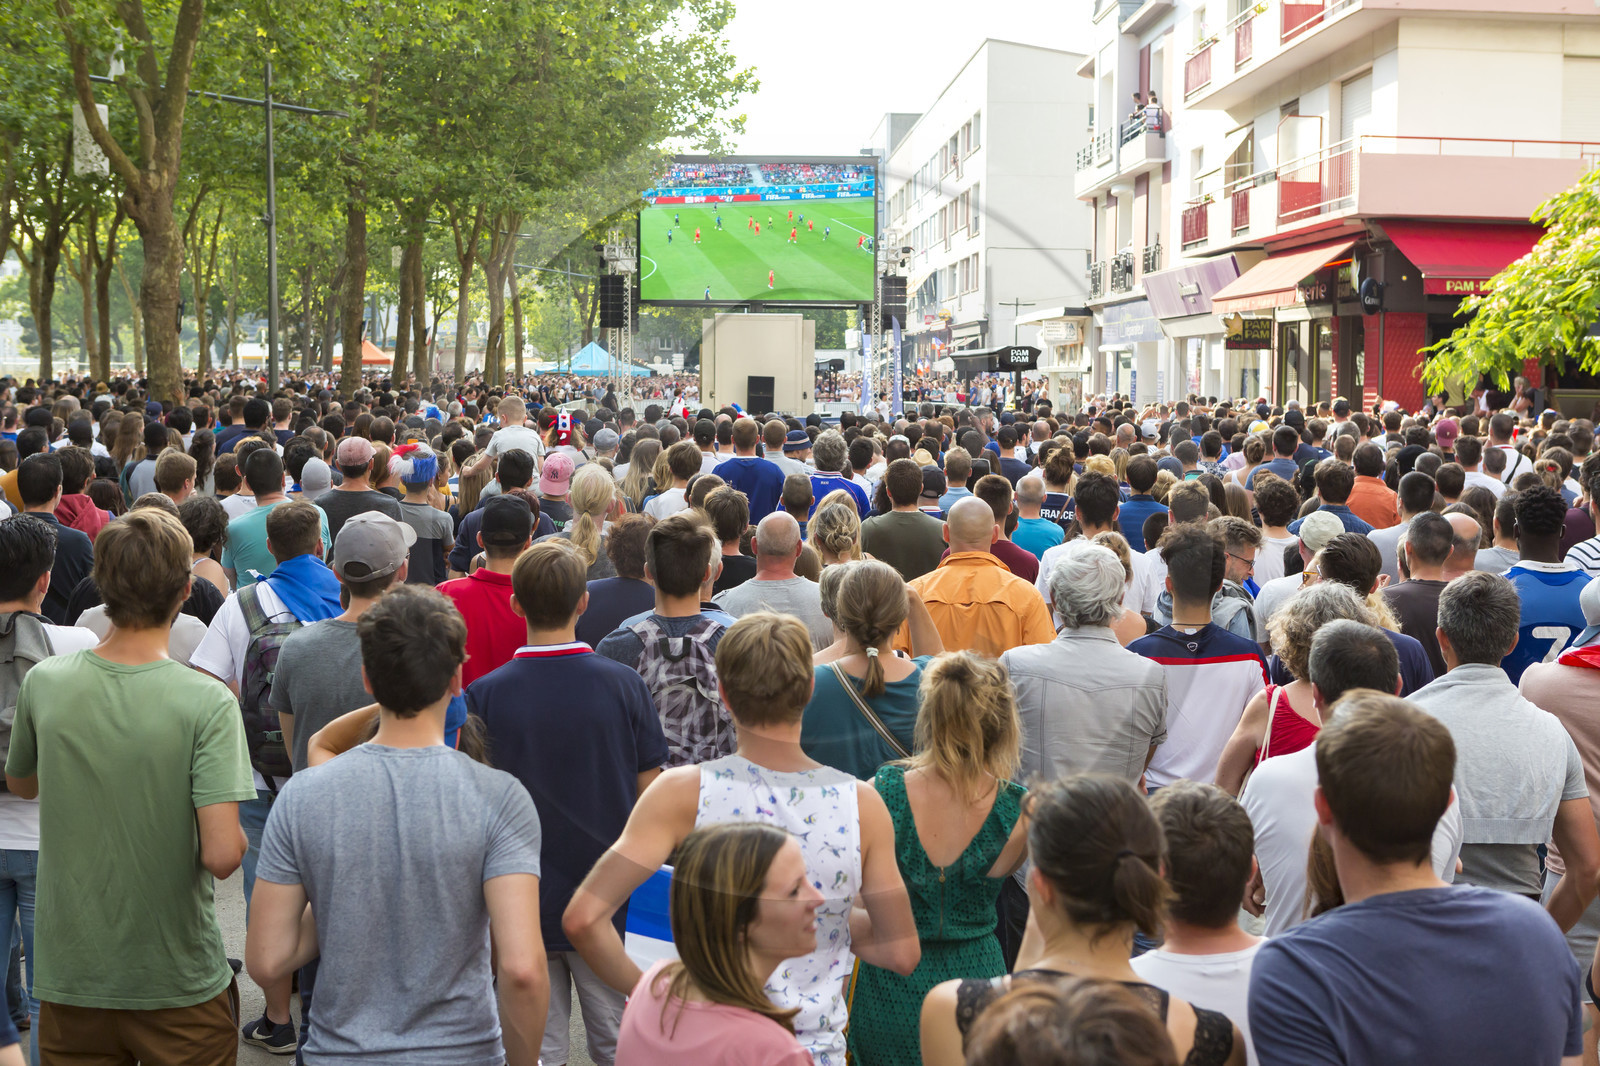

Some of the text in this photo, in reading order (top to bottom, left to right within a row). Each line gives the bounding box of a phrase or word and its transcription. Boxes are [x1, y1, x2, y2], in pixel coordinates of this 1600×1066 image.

[1446, 281, 1474, 291] PAM
[1244, 320, 1270, 329] PAM
[1244, 330, 1270, 339] PAM
[1532, 626, 1571, 663] 7
